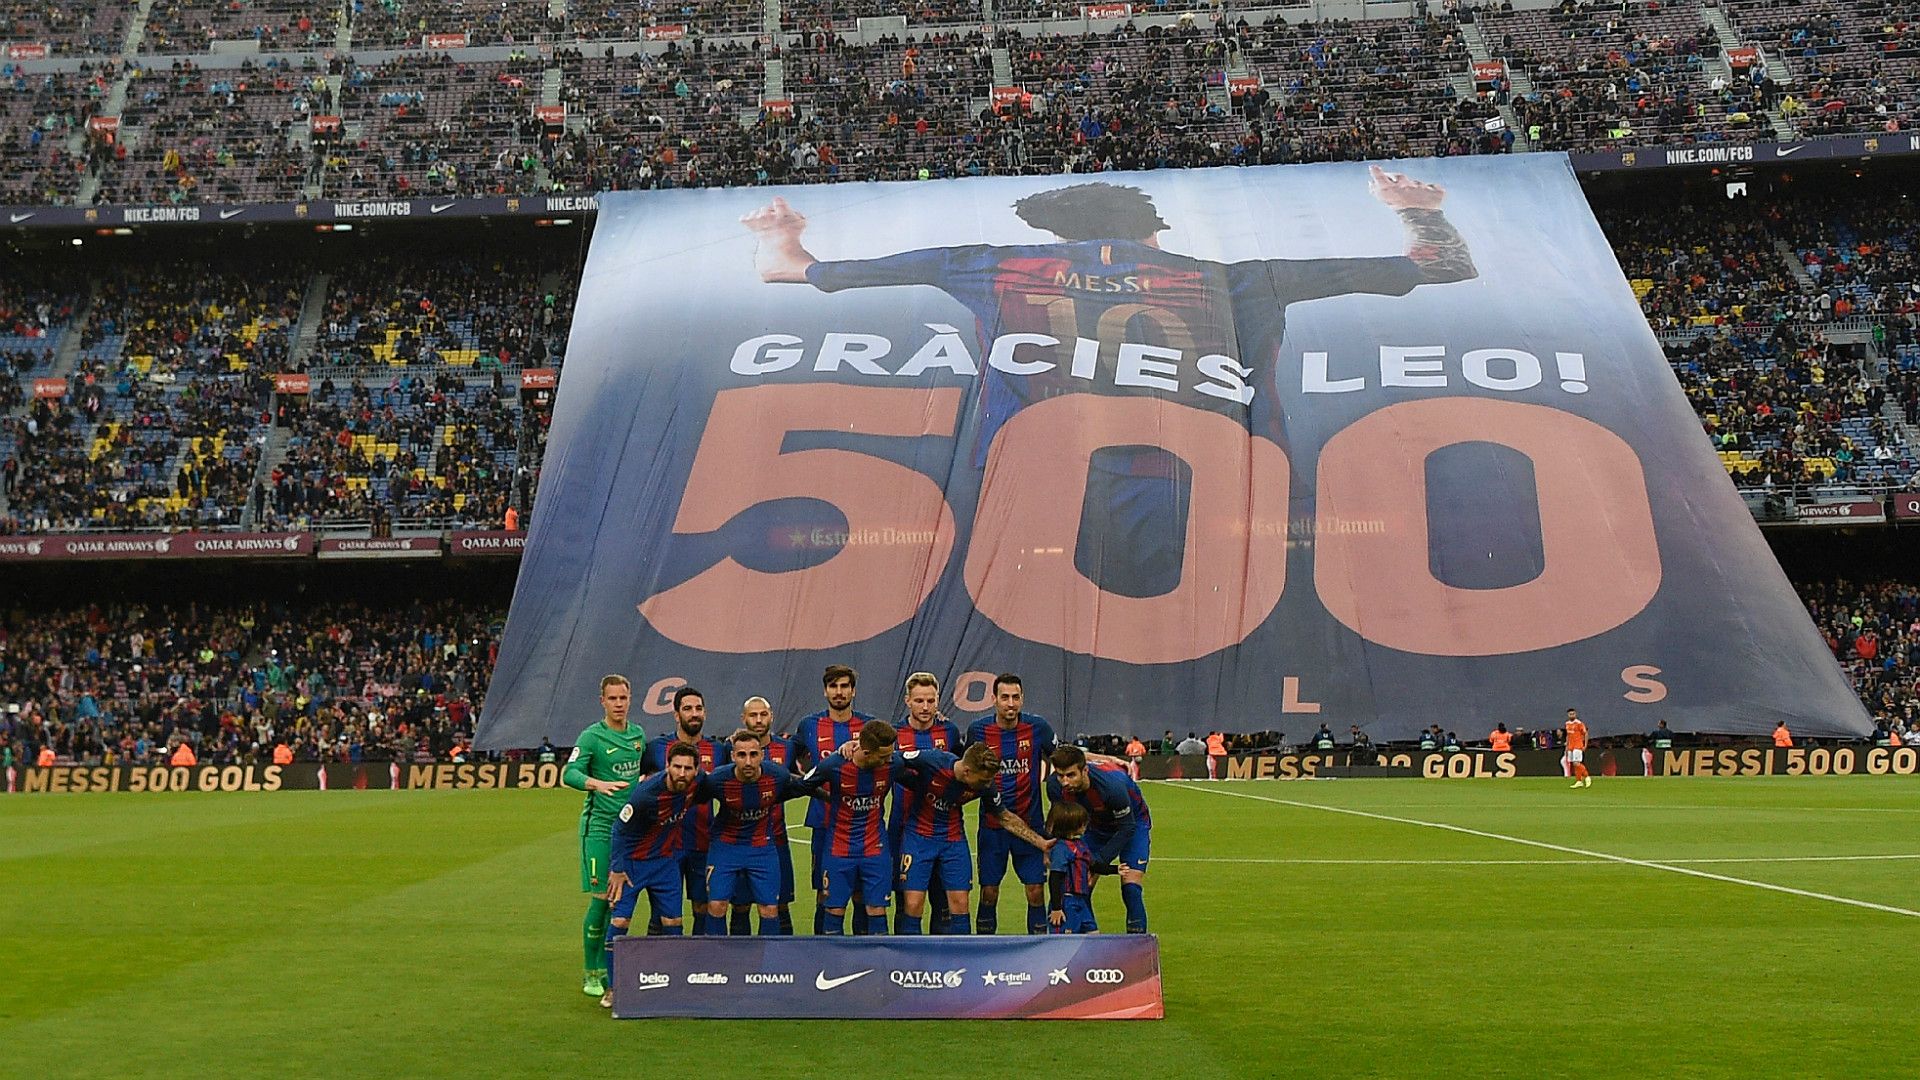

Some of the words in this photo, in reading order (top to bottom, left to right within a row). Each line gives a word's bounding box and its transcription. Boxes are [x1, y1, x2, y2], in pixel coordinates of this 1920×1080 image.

[1666, 146, 1753, 164] NIKE.COM/FCB
[124, 208, 200, 222] NIKE.COM/FCB
[334, 202, 411, 217] NIKE.COM/FCB
[729, 323, 1256, 406] GRÀCIES
[1302, 345, 1589, 394] LEO!
[637, 382, 1663, 664] 500
[195, 540, 233, 551] QATAR
[235, 540, 282, 550] AIRWAYS
[462, 539, 500, 550] QATAR
[811, 528, 879, 546] Estrella
[66, 542, 104, 553] QATAR
[107, 541, 154, 552] AIRWAYS
[339, 541, 365, 551] QATAR
[366, 541, 400, 550] AIRWAYS
[998, 758, 1028, 768] ATAR
[1422, 753, 1517, 779] GOLS
[1663, 749, 1775, 776] MESSI
[1786, 747, 1855, 775] 500
[1866, 747, 1917, 775] GO
[25, 767, 120, 793] MESSI
[129, 766, 190, 792] 500
[198, 765, 283, 792] GOLS
[408, 764, 508, 789] MESSI
[639, 972, 670, 985] beko
[745, 974, 794, 984] KONAMI
[890, 970, 943, 986] QATAR
